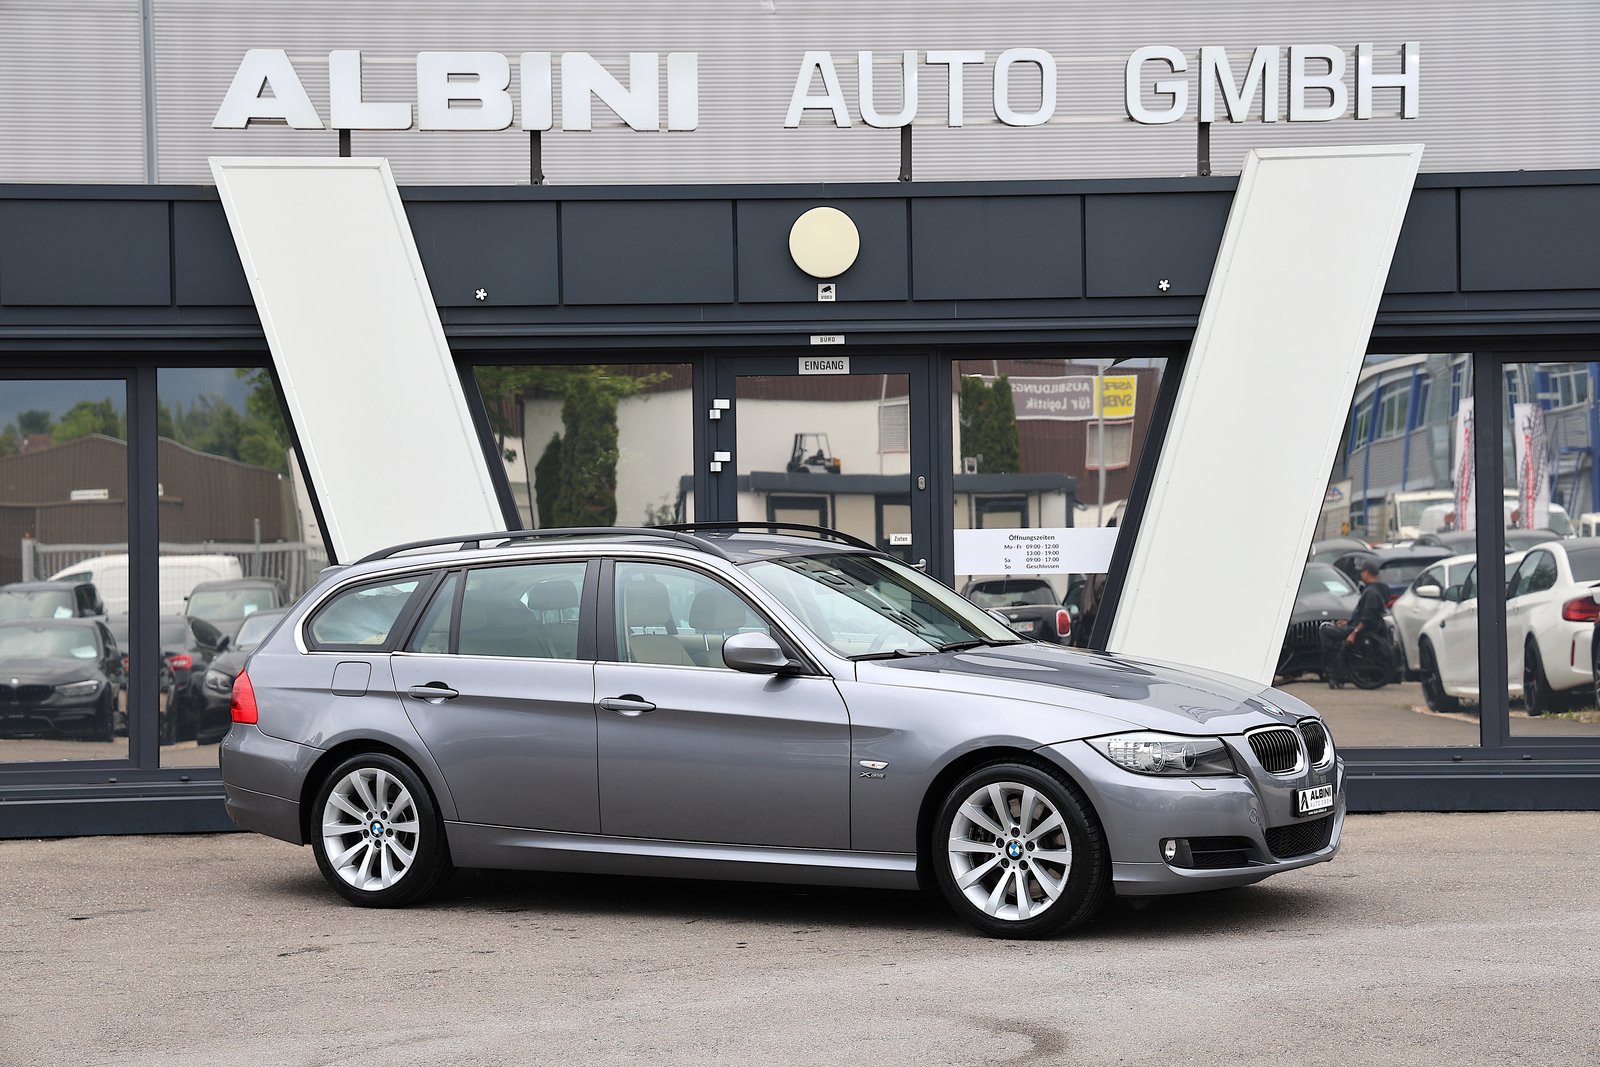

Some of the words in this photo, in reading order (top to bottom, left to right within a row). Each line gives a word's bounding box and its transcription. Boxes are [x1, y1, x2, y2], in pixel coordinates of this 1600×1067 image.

[211, 48, 699, 132] ALBINI
[783, 47, 1058, 129] AUTO
[1124, 41, 1421, 125] GMBH
[804, 360, 844, 371] EINGANG
[1008, 534, 1056, 542] Öffnungszeiten
[1310, 787, 1331, 801] ALBINI
